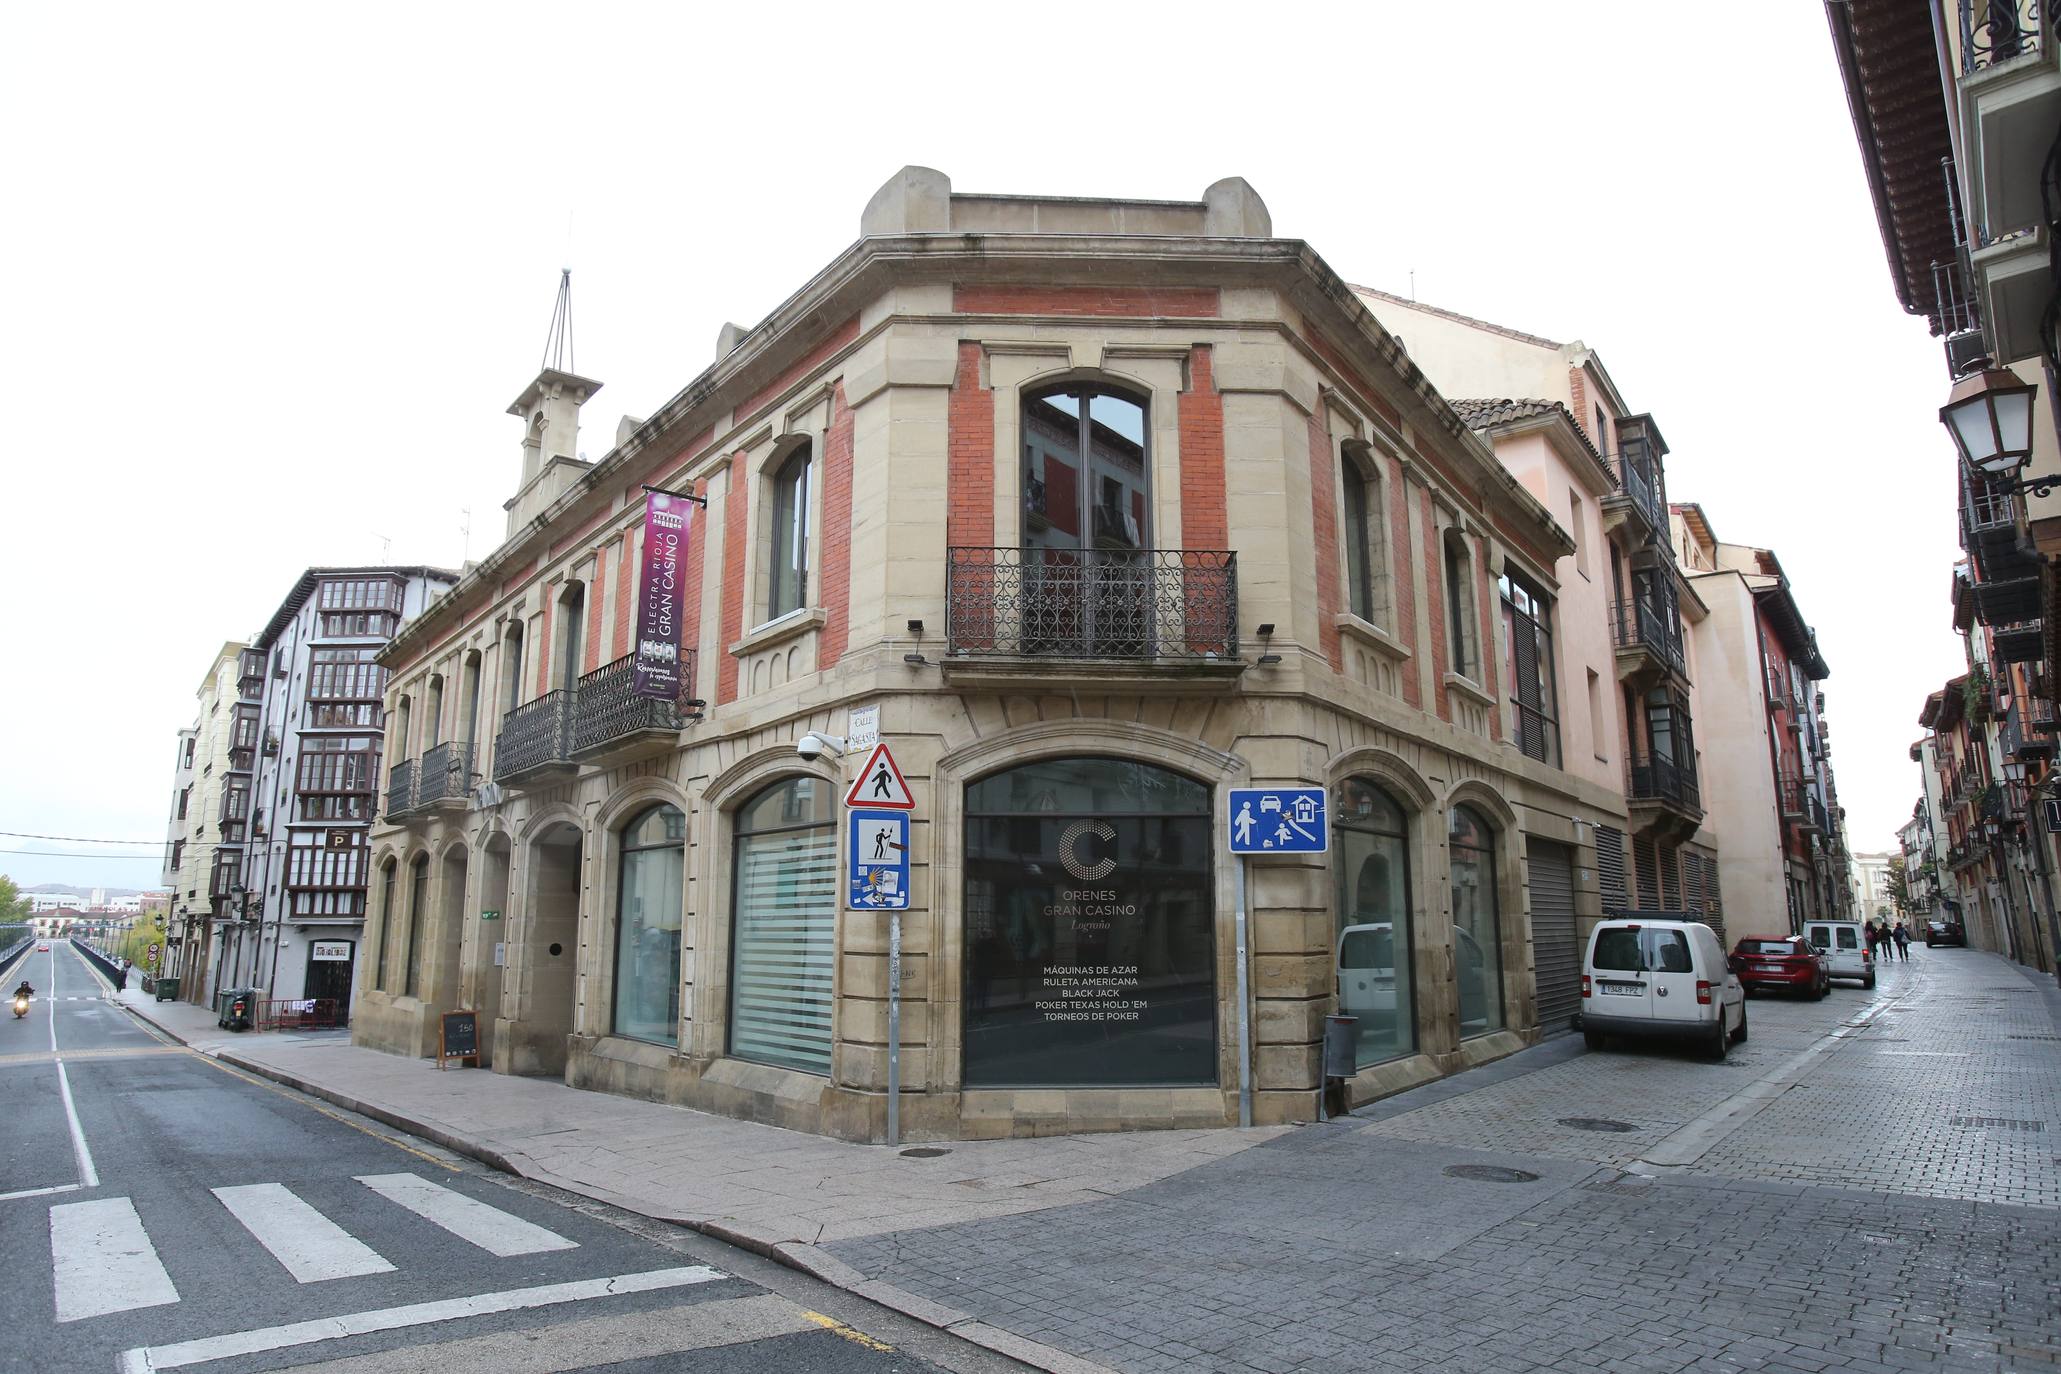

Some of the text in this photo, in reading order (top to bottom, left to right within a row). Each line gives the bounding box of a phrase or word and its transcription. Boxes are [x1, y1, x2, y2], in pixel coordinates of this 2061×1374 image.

[647, 532, 664, 634] ELECTRA RIOJA
[659, 534, 678, 636] GRAN CASINO
[334, 836, 344, 847] P
[1063, 890, 1116, 901] ORENES
[1043, 904, 1136, 916] GRAN CASINO
[1043, 965, 1138, 975] MÁQUINAS DE AZAR
[1043, 978, 1138, 986] RULETA AMERICANA
[1062, 989, 1120, 998] BLACK JACK
[1035, 1001, 1068, 1009] POKER
[1070, 1001, 1101, 1009] TEXAS
[1102, 1001, 1130, 1009] HOLD
[1044, 1012, 1139, 1021] TORNEOS DE POKER
